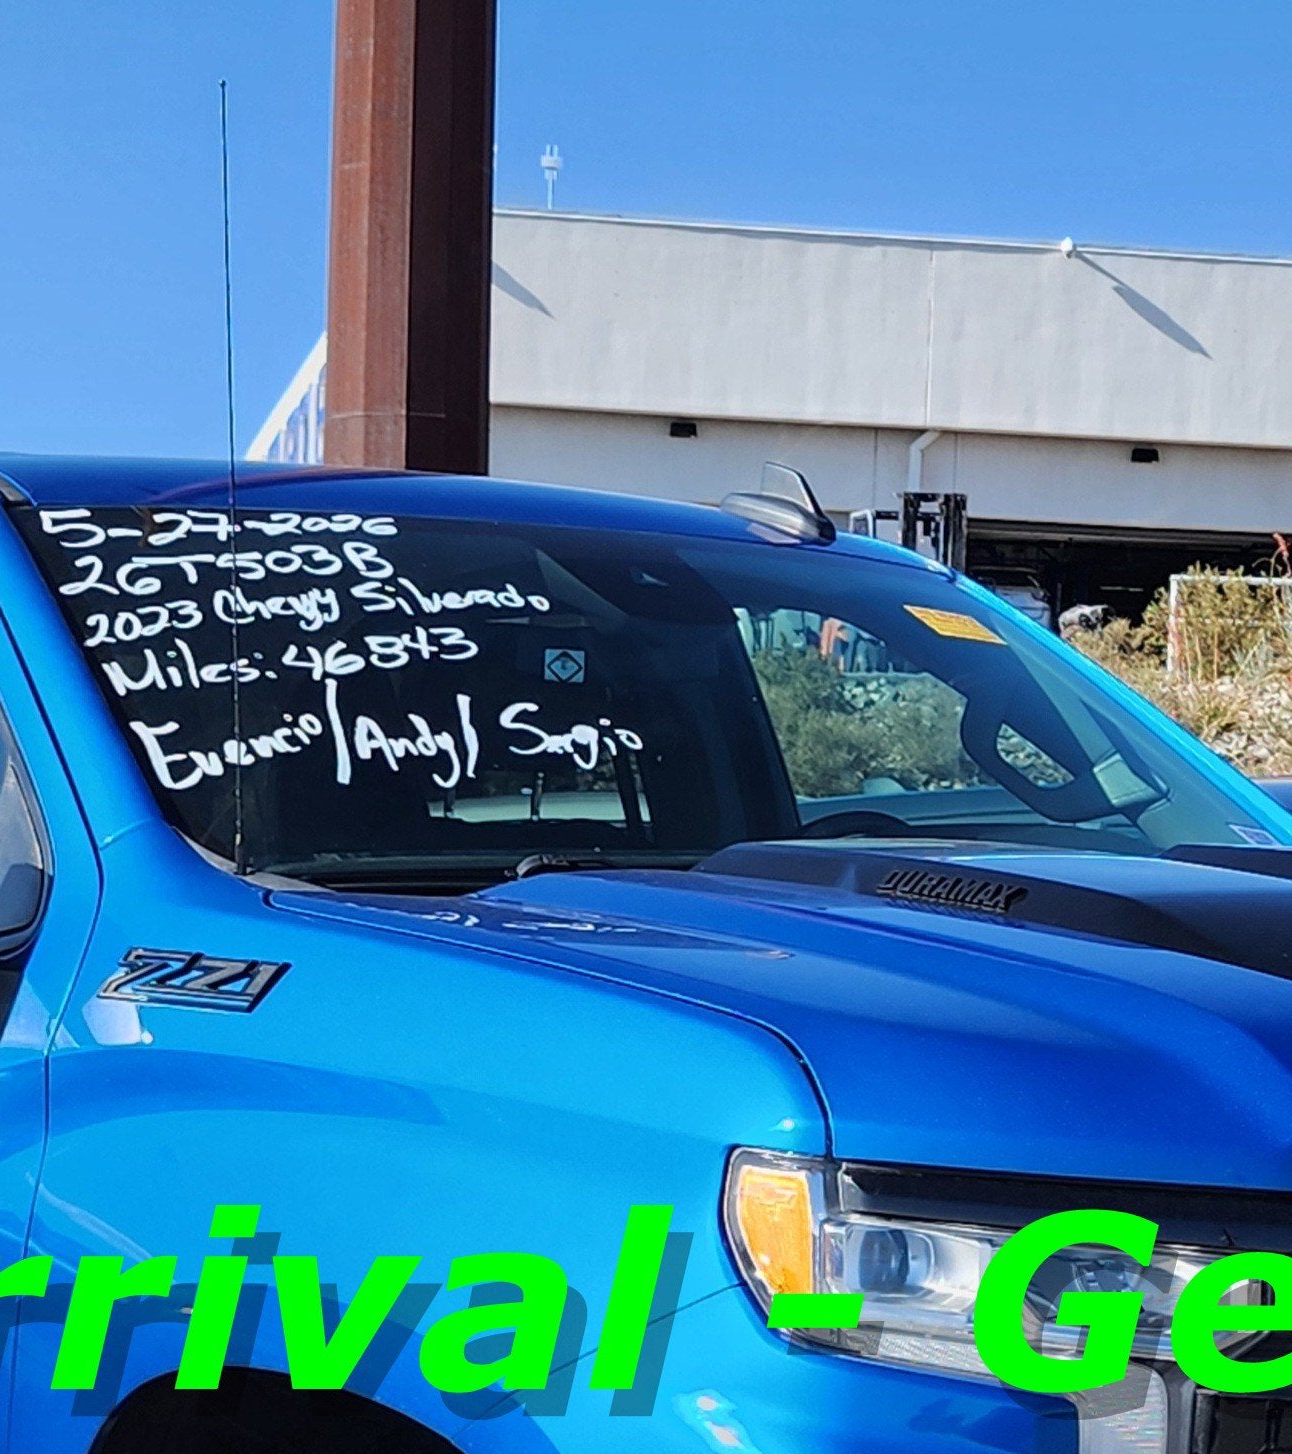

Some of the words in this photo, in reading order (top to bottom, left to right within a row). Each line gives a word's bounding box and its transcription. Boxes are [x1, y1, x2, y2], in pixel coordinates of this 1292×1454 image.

[39, 509, 399, 549] 5-27-2026
[58, 541, 395, 596] 26T503B
[84, 600, 204, 647] 2023
[349, 576, 551, 618] Silverado
[101, 637, 279, 697] Miles:
[876, 868, 1030, 914] DURAMAX
[97, 946, 293, 1014] Z71
